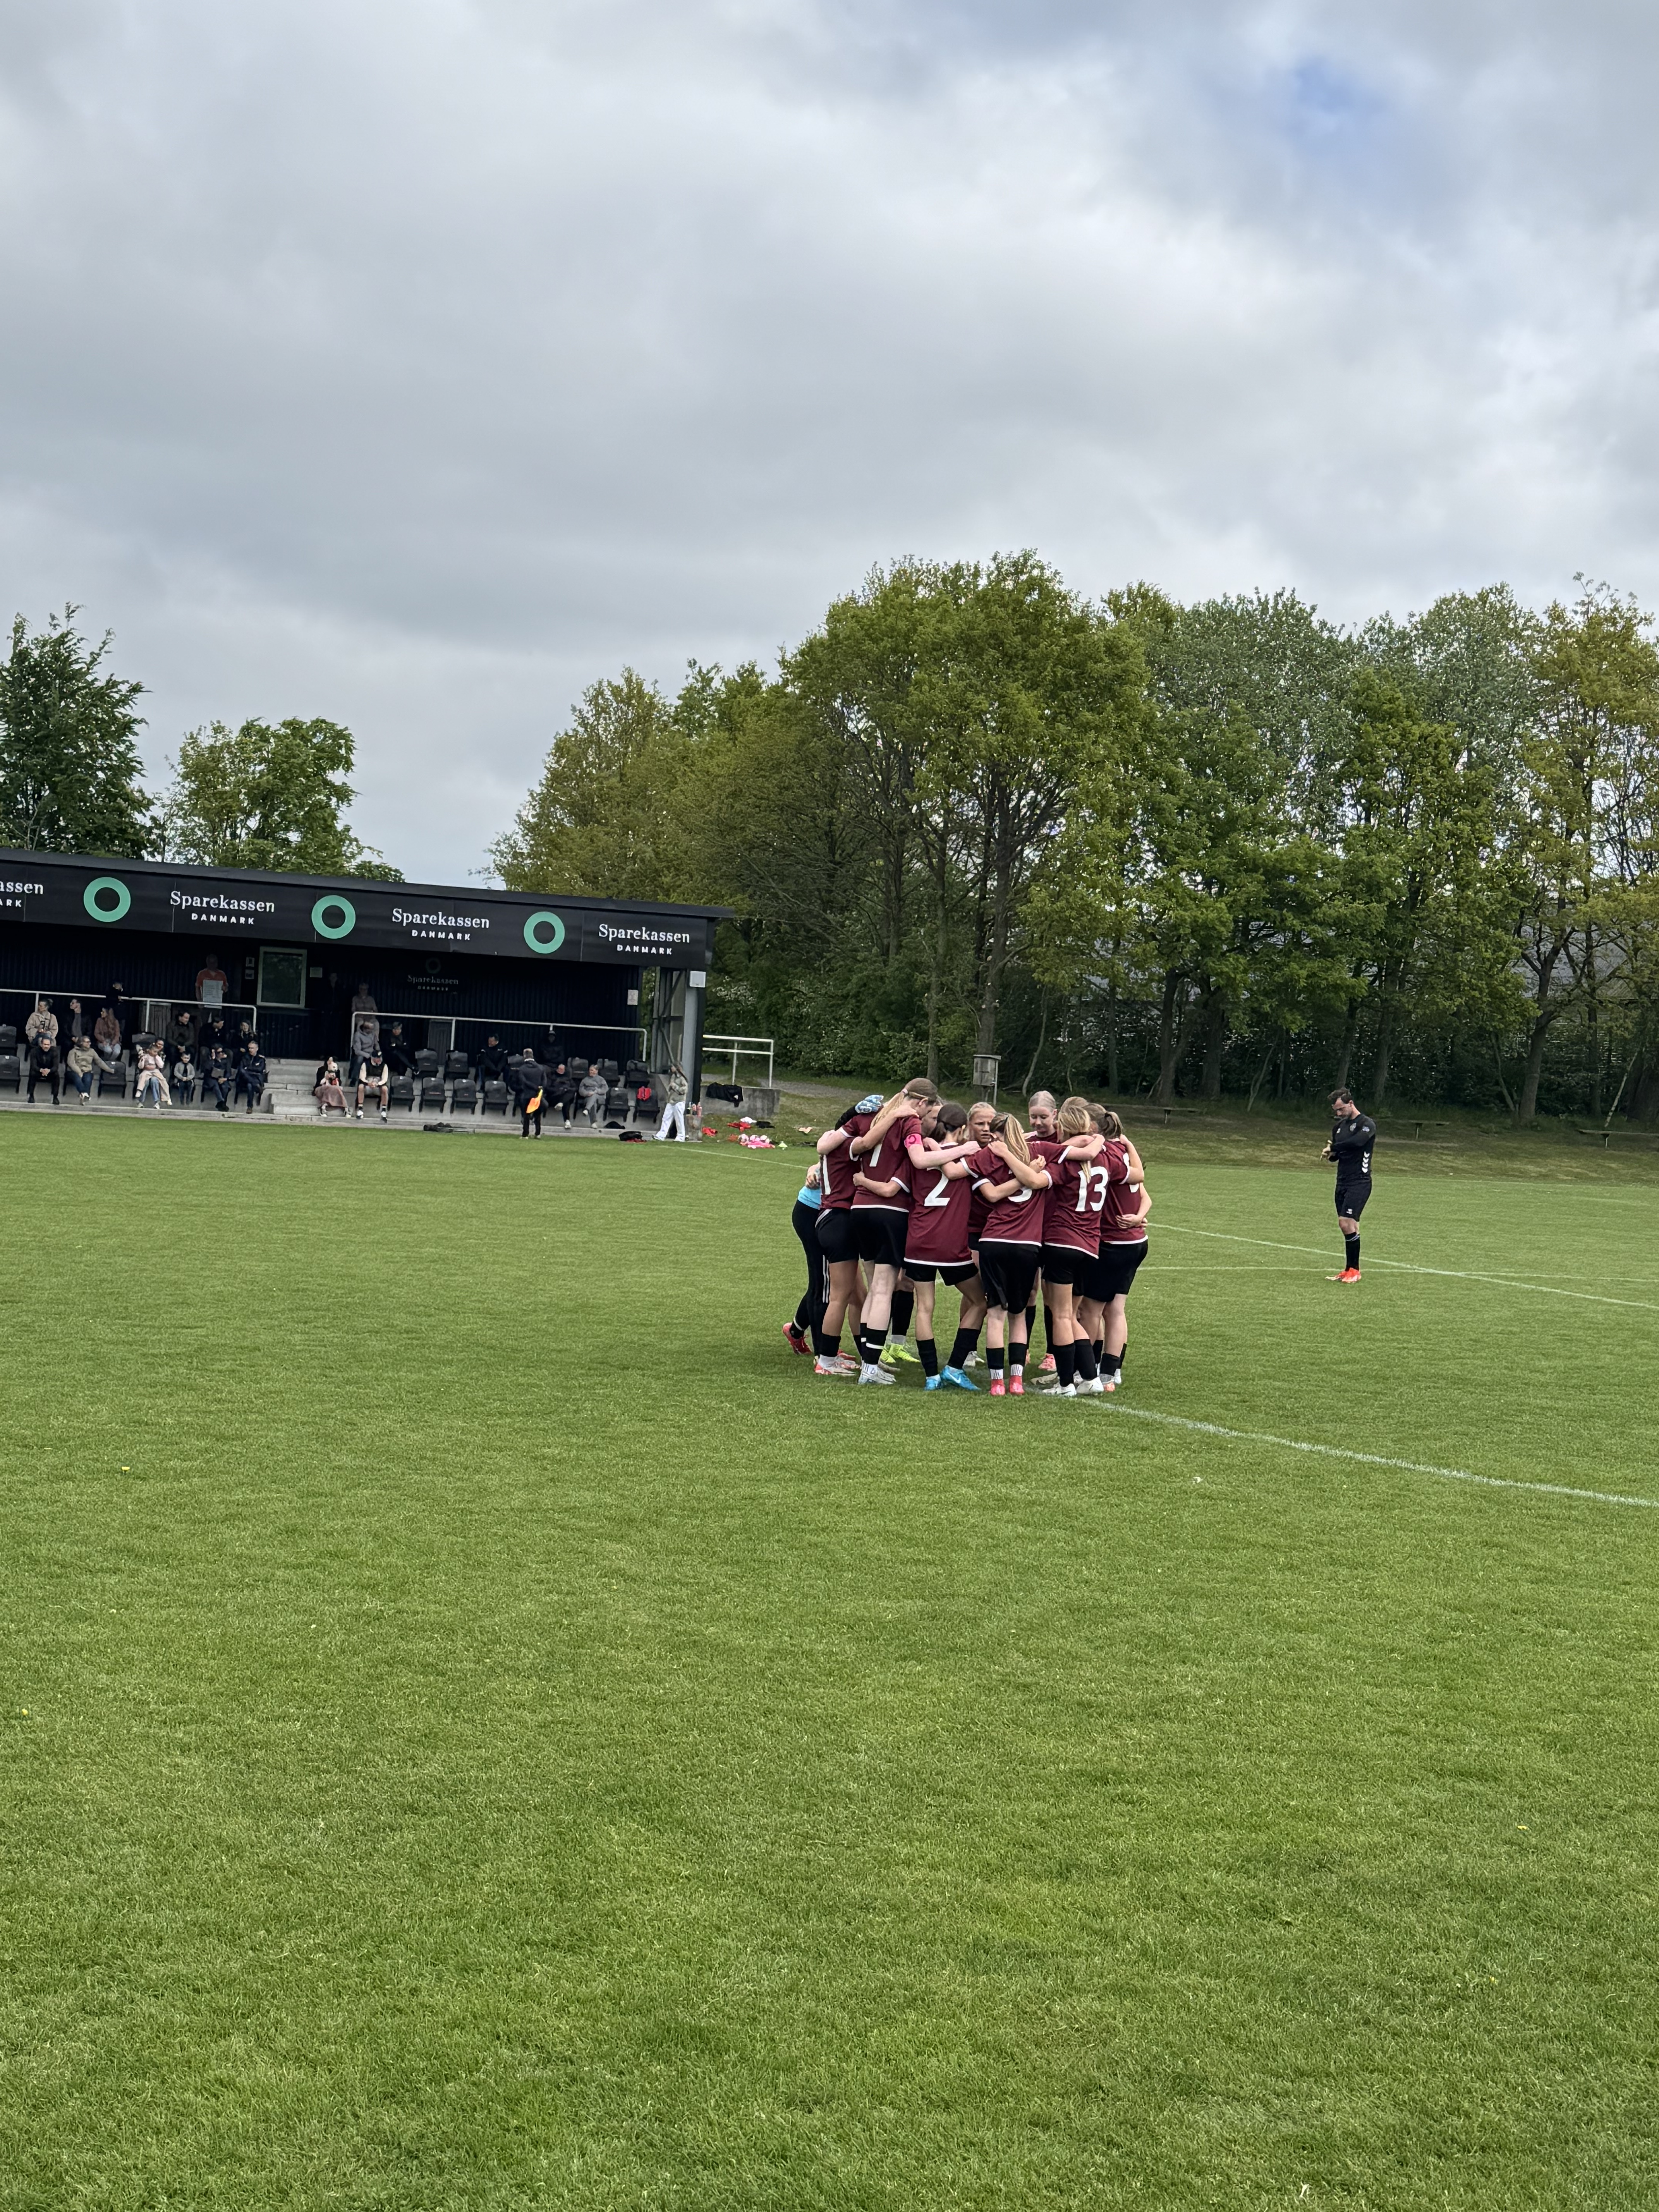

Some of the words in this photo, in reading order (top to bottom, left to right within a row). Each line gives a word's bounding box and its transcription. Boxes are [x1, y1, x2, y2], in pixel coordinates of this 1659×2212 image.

[170, 890, 275, 912] Sparekassen
[191, 913, 254, 925] DANMARK
[392, 908, 489, 928] Sparekassen
[412, 929, 471, 941] DANMARK
[599, 923, 690, 943] Sparekassen
[617, 944, 672, 955] DANMARK
[924, 1166, 950, 1206] 2
[1075, 1166, 1108, 1211] 13
